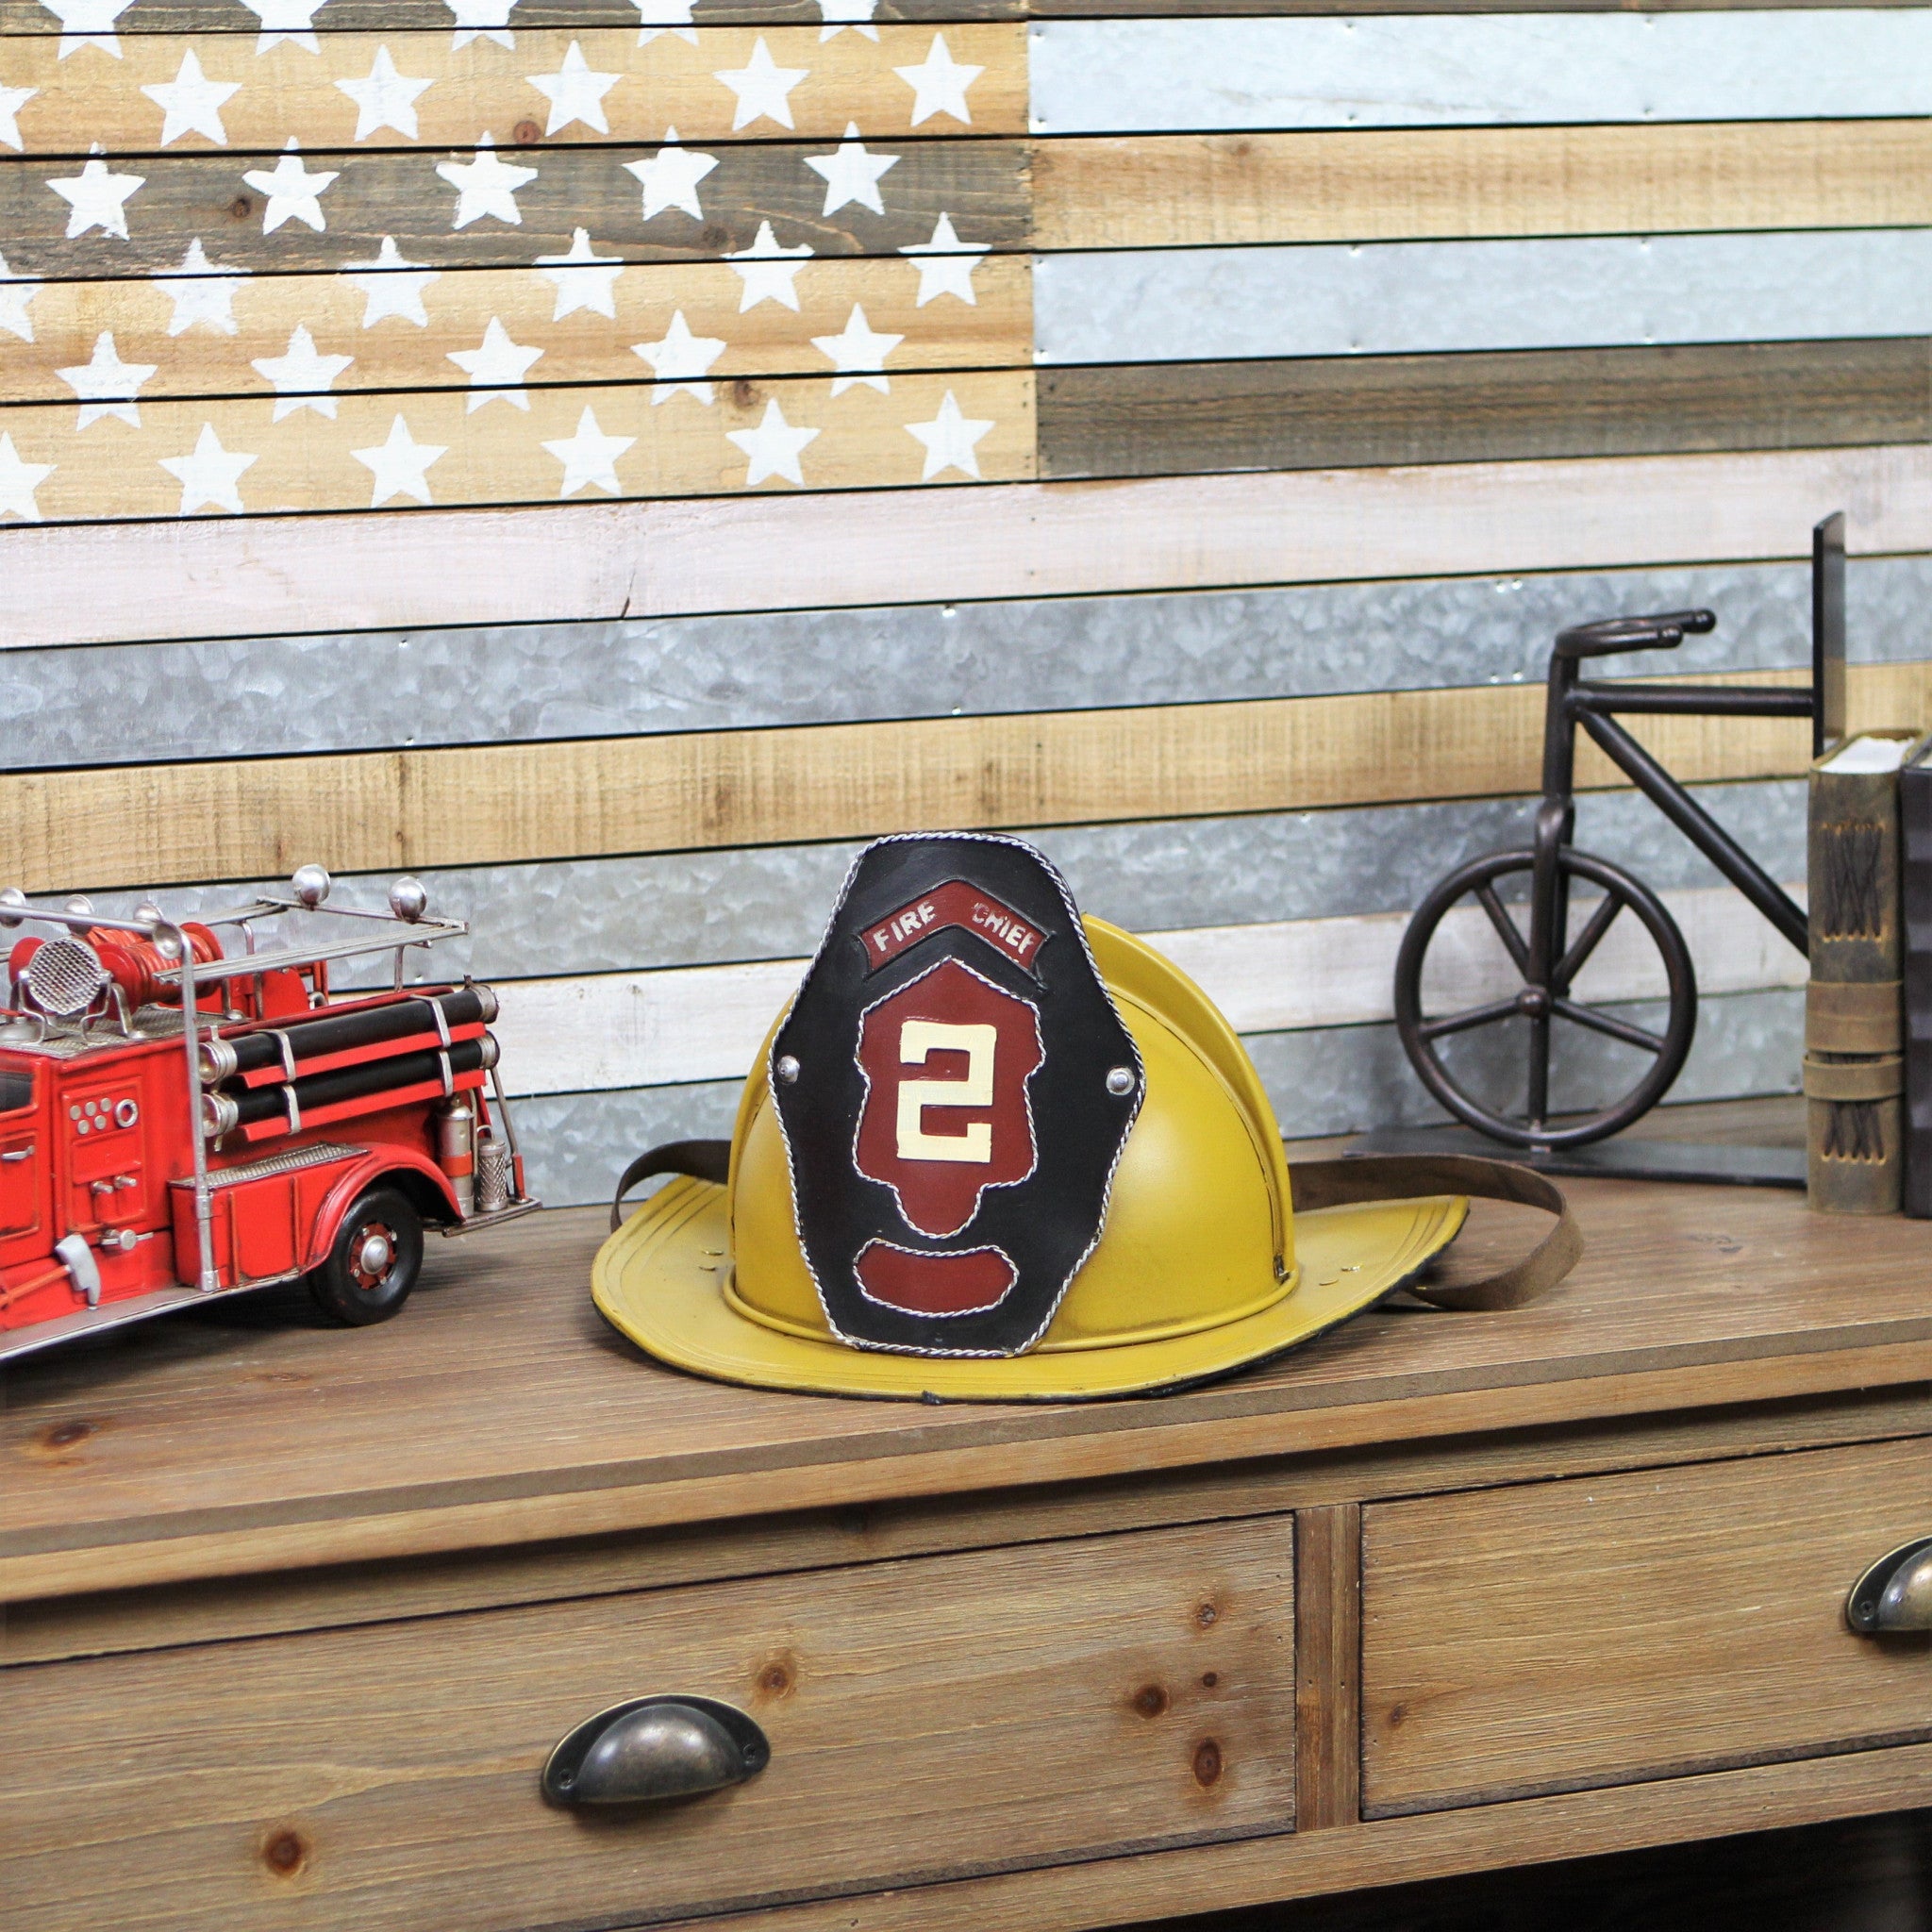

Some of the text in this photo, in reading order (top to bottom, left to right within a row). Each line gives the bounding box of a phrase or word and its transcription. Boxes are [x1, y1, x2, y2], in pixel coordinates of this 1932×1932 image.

[873, 901, 1036, 955] FIRE CHIEF
[896, 1021, 997, 1164] 2
